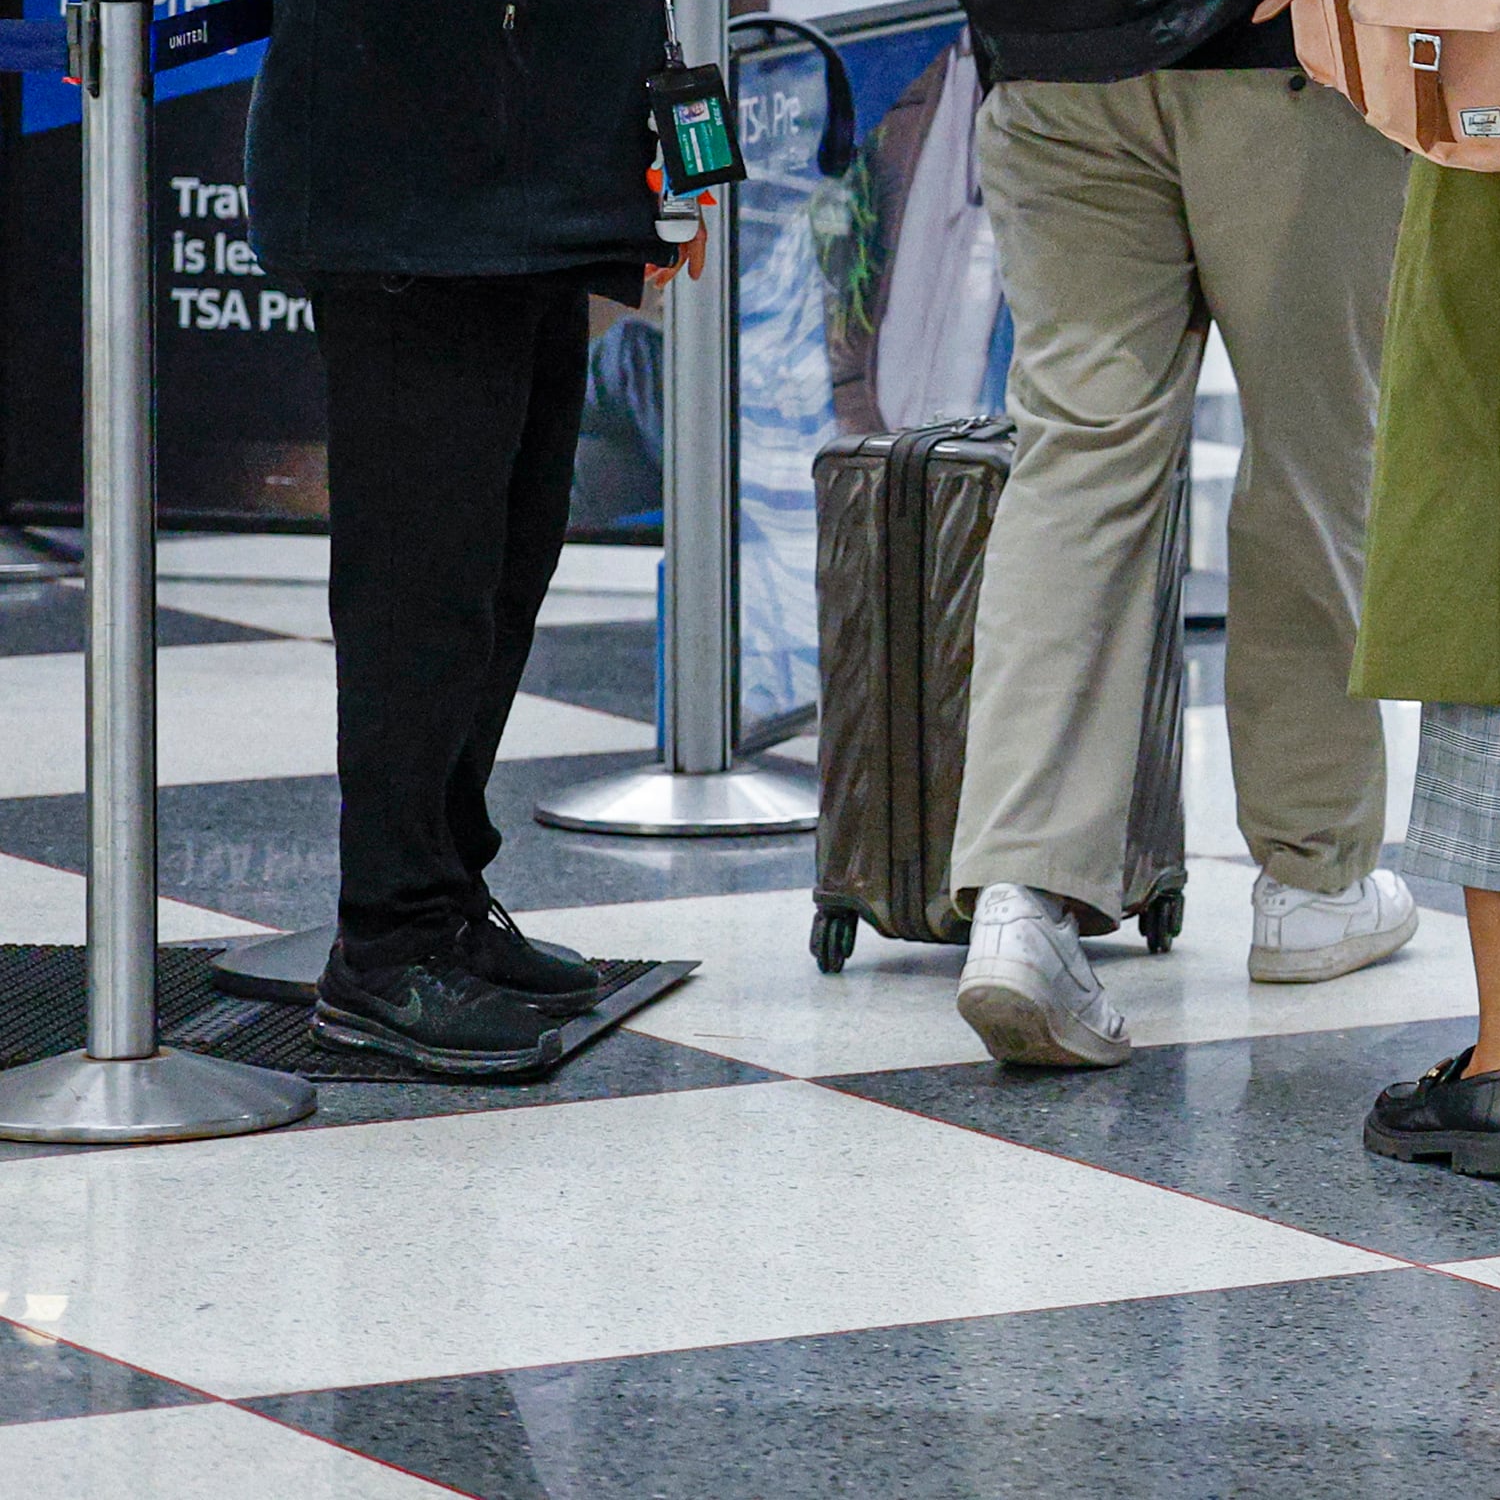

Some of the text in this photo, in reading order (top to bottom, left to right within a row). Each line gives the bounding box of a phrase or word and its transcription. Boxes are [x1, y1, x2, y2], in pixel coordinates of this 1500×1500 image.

[168, 29, 203, 50] UNITED
[172, 230, 206, 274] is
[171, 287, 251, 331] TSA
